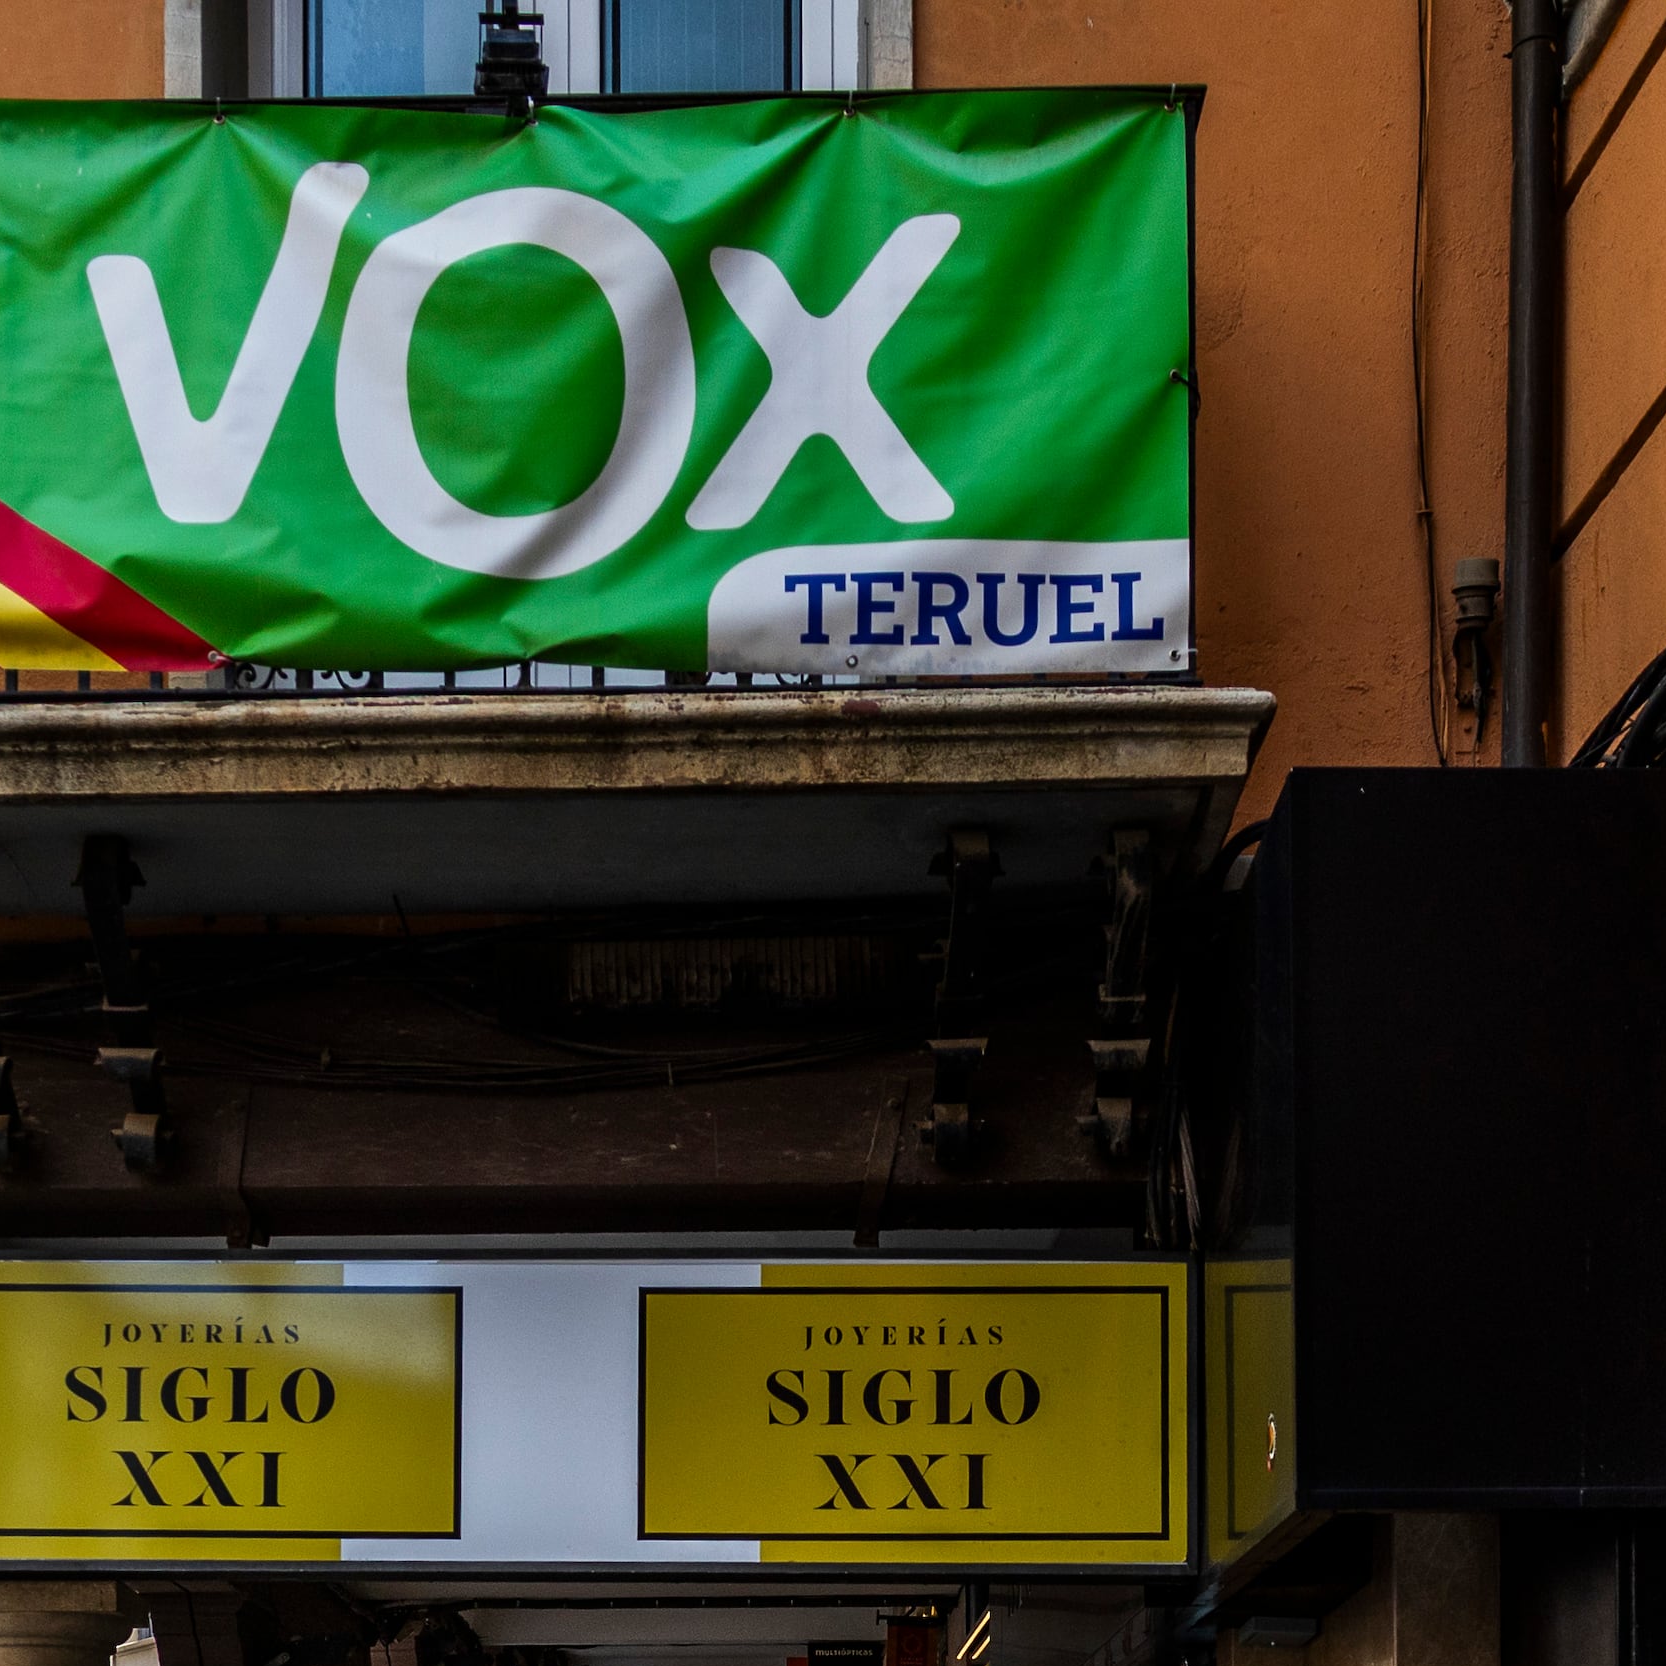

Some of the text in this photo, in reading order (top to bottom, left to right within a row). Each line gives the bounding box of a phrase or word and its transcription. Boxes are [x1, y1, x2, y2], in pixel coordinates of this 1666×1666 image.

[86, 161, 961, 580] VOX
[783, 569, 1165, 648] TERUEL
[102, 1316, 302, 1348] JOYERÍAS
[802, 1318, 1006, 1349] JOYERÍAS
[65, 1364, 336, 1426] SIGLO
[767, 1367, 1042, 1428] SIGLO
[112, 1449, 284, 1508] XXI
[815, 1452, 993, 1512] XXI
